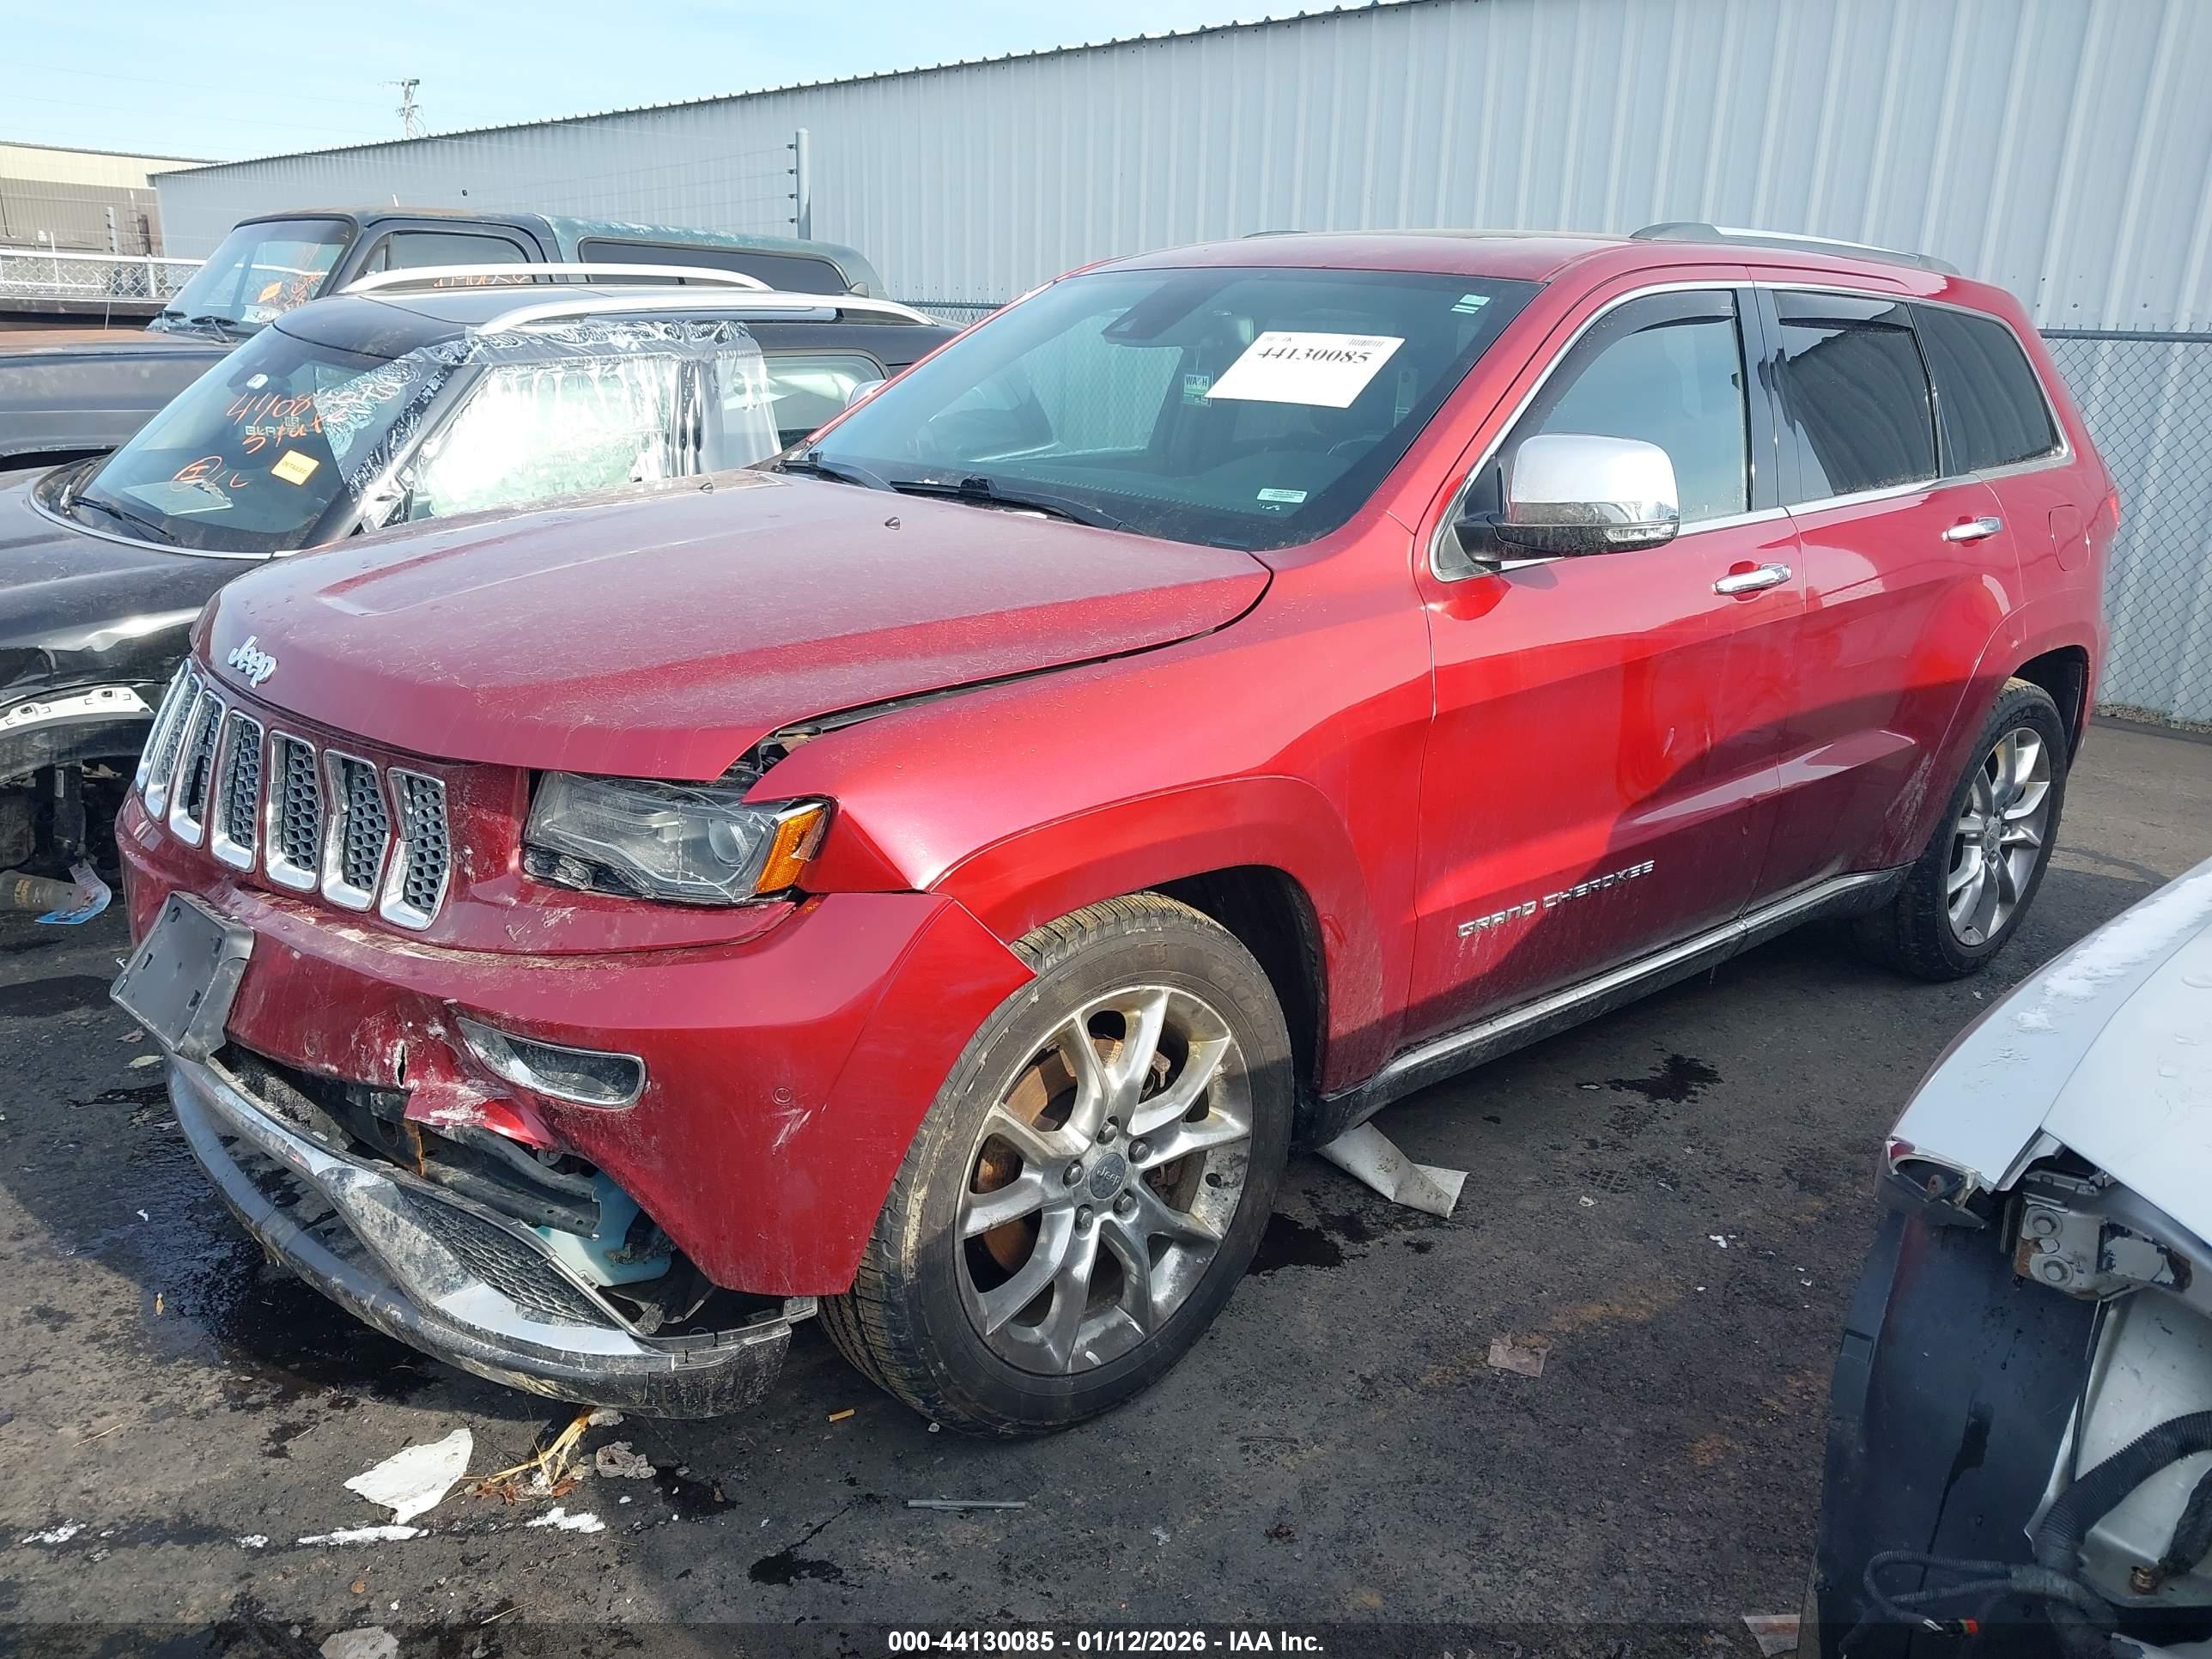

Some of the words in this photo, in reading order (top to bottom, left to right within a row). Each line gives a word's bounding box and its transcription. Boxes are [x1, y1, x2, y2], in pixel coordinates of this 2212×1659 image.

[1257, 347, 1372, 364] 44130085
[228, 635, 276, 689] Jeep
[1457, 901, 1537, 939] GRAND
[1542, 860, 1656, 909] CHEROKEE
[1097, 1166, 1121, 1187] Jeep
